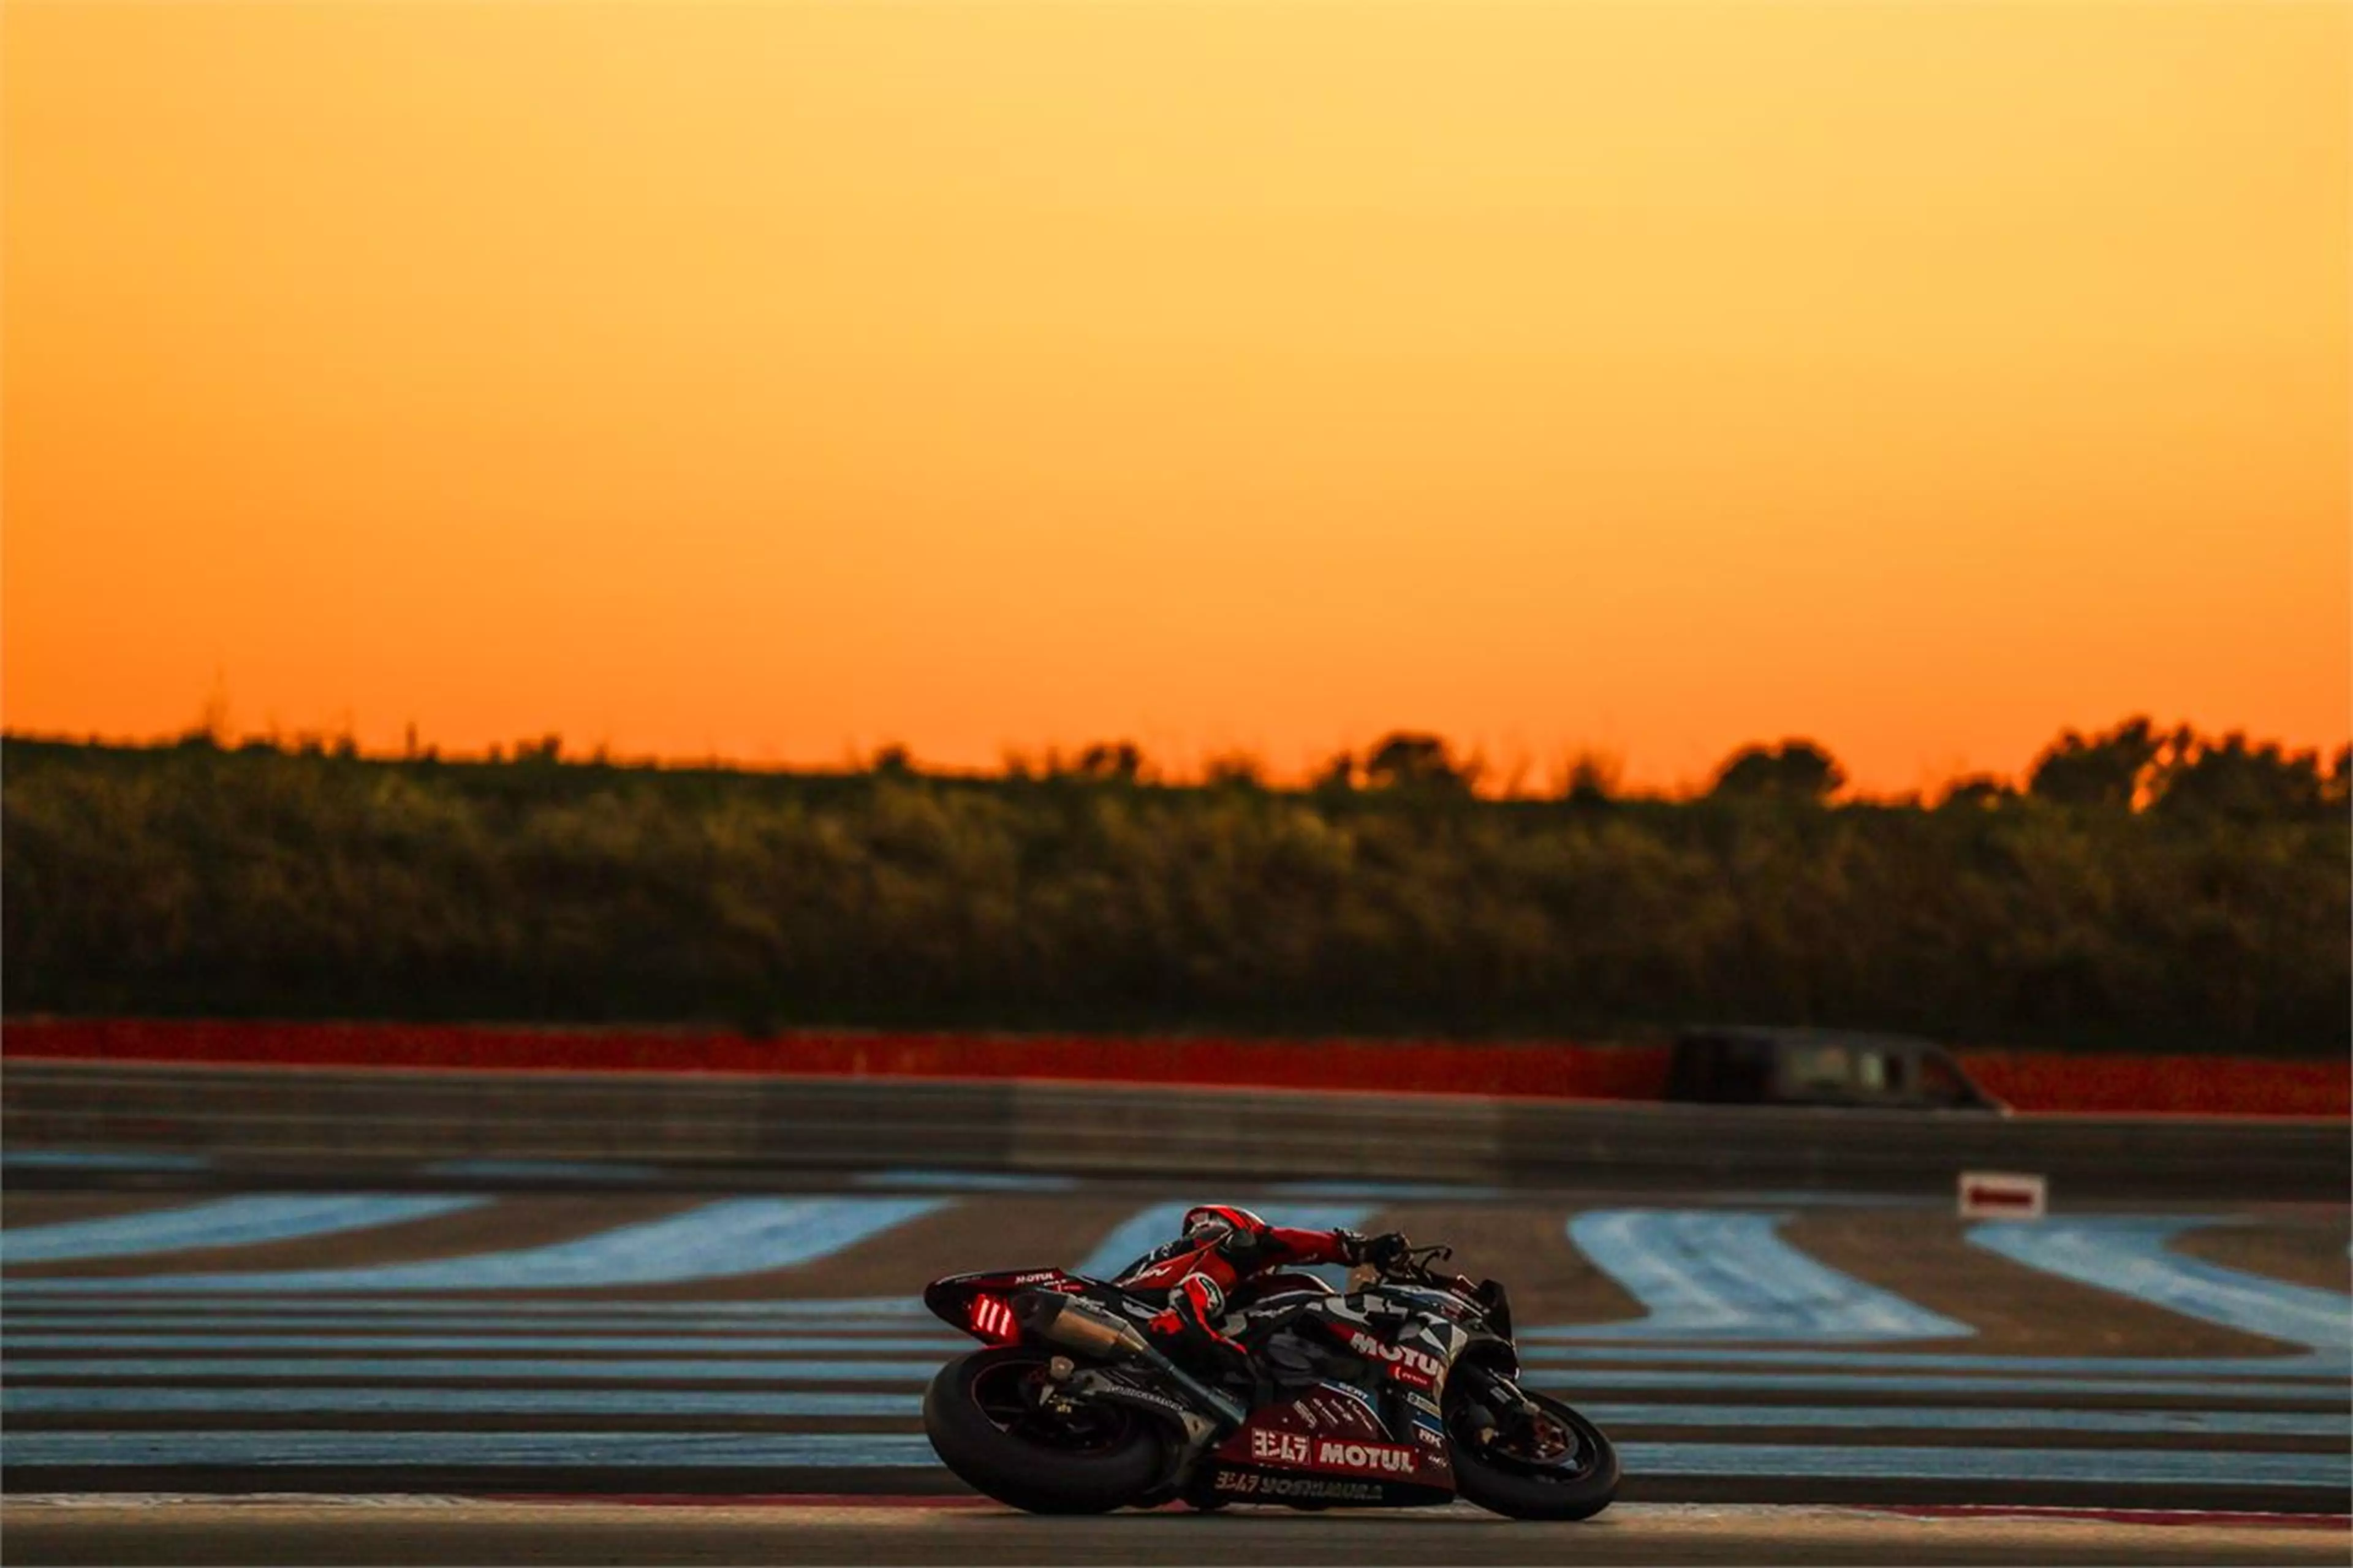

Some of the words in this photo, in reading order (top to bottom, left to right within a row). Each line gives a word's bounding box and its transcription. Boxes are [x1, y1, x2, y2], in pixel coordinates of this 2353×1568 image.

[1014, 1272, 1055, 1285] MOTUL
[1349, 1331, 1441, 1376] MOTU
[1319, 1442, 1415, 1474] MOTUL
